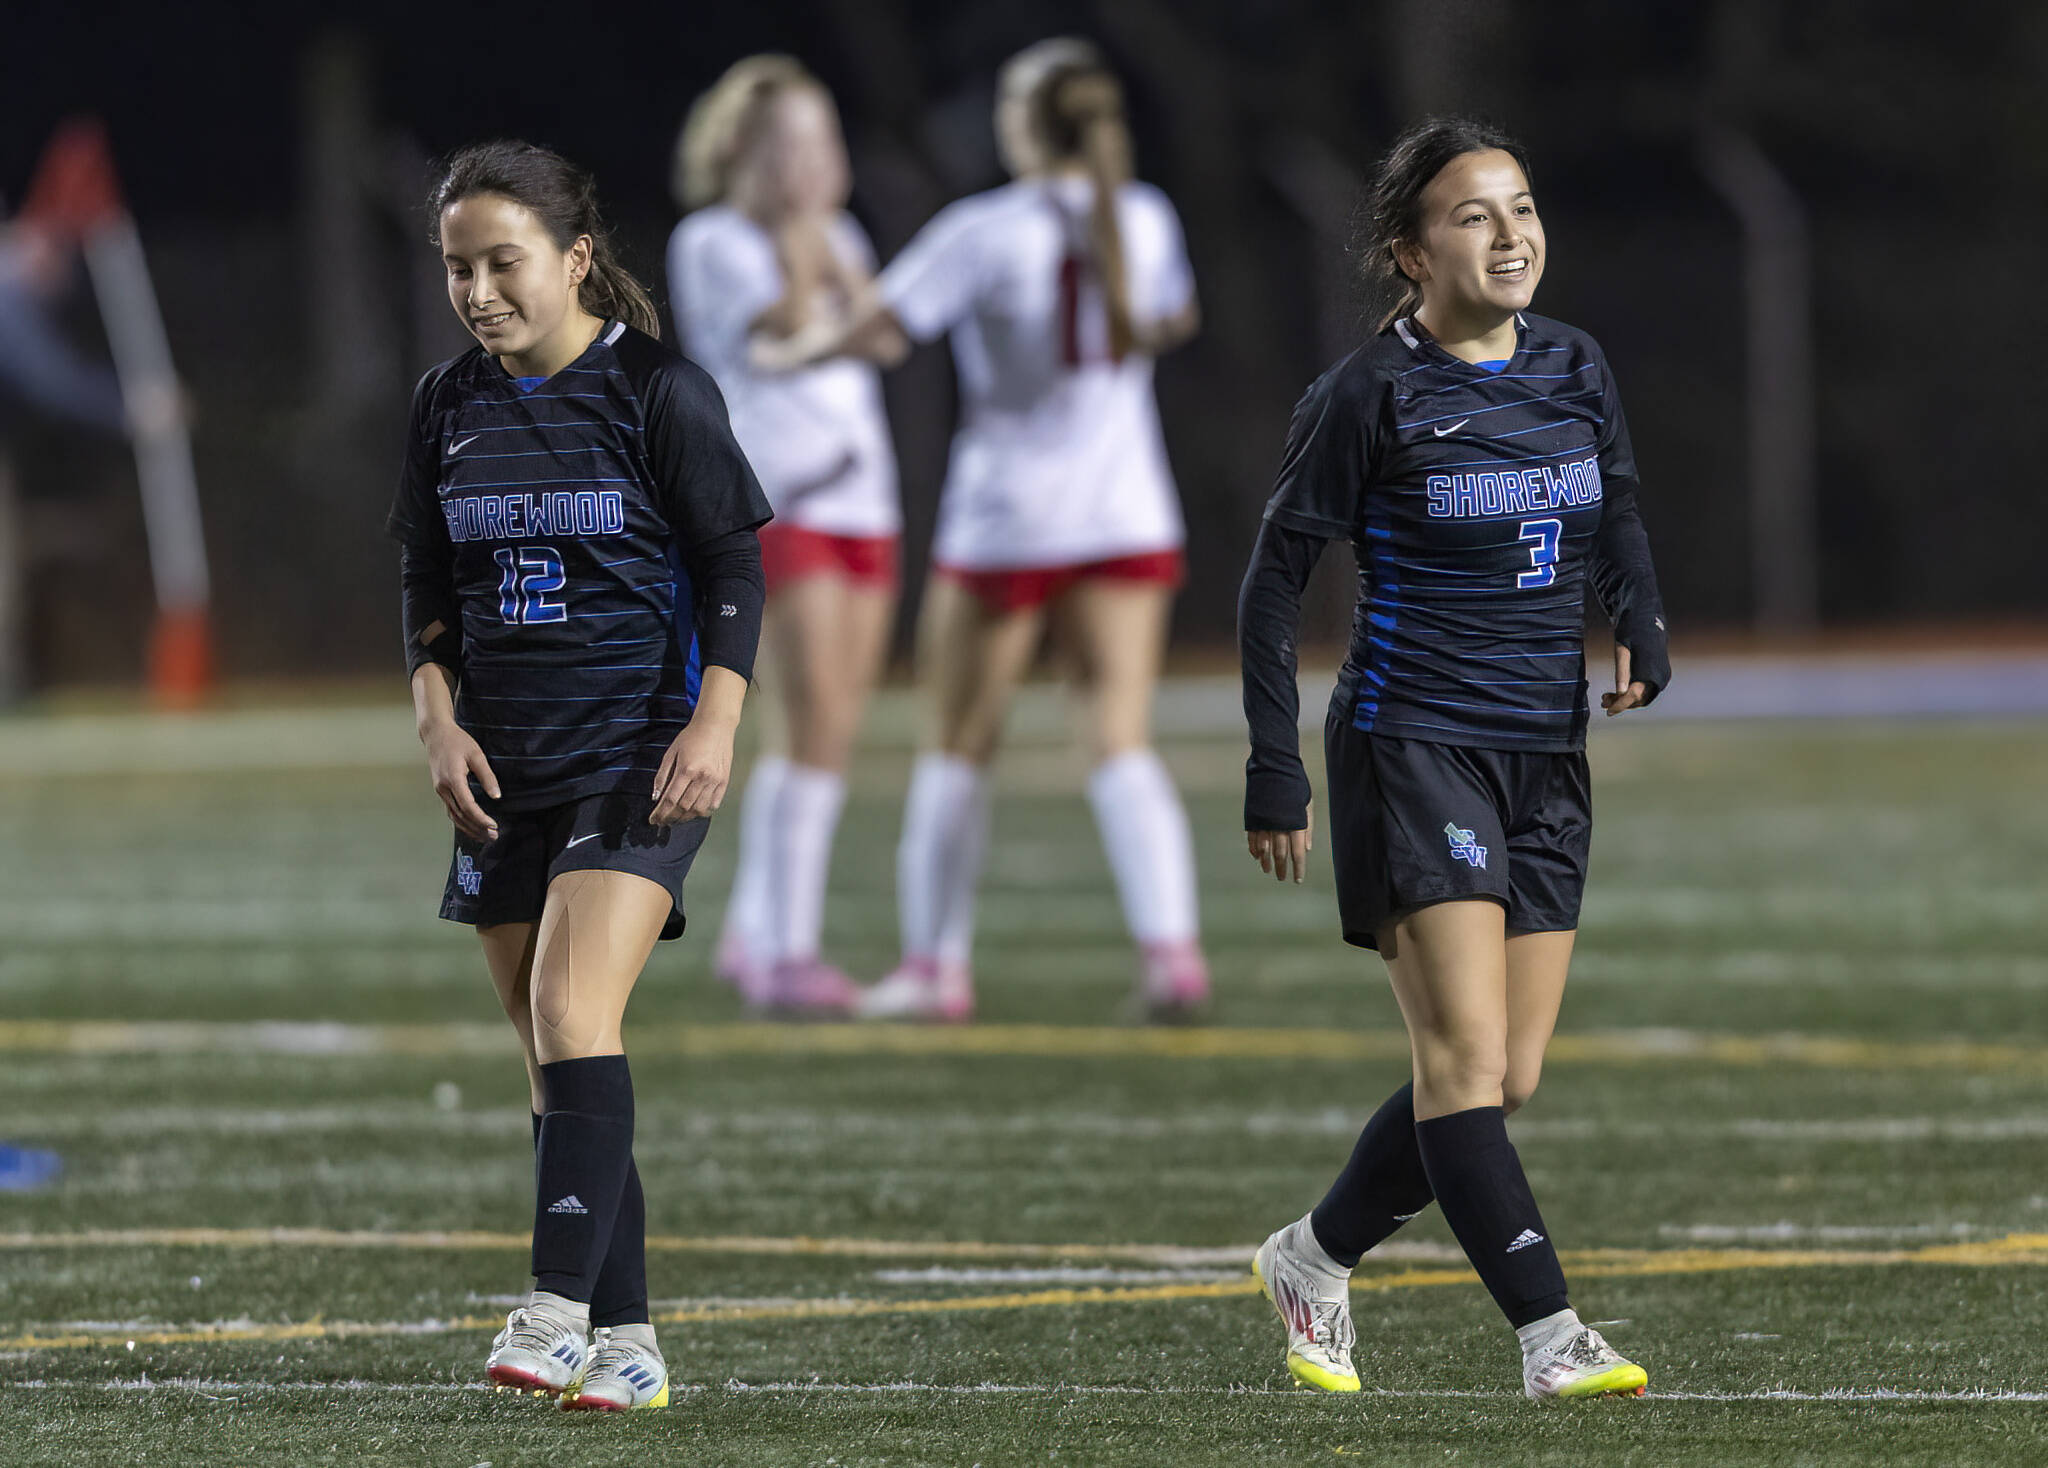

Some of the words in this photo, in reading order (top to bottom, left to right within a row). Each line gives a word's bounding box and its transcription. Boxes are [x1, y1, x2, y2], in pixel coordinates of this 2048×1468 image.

[441, 491, 624, 542] HOREWOOD
[1427, 455, 1602, 517] SHOREWOO
[1517, 518, 1562, 589] 3
[494, 547, 567, 625] 12
[548, 1205, 588, 1214] adidas
